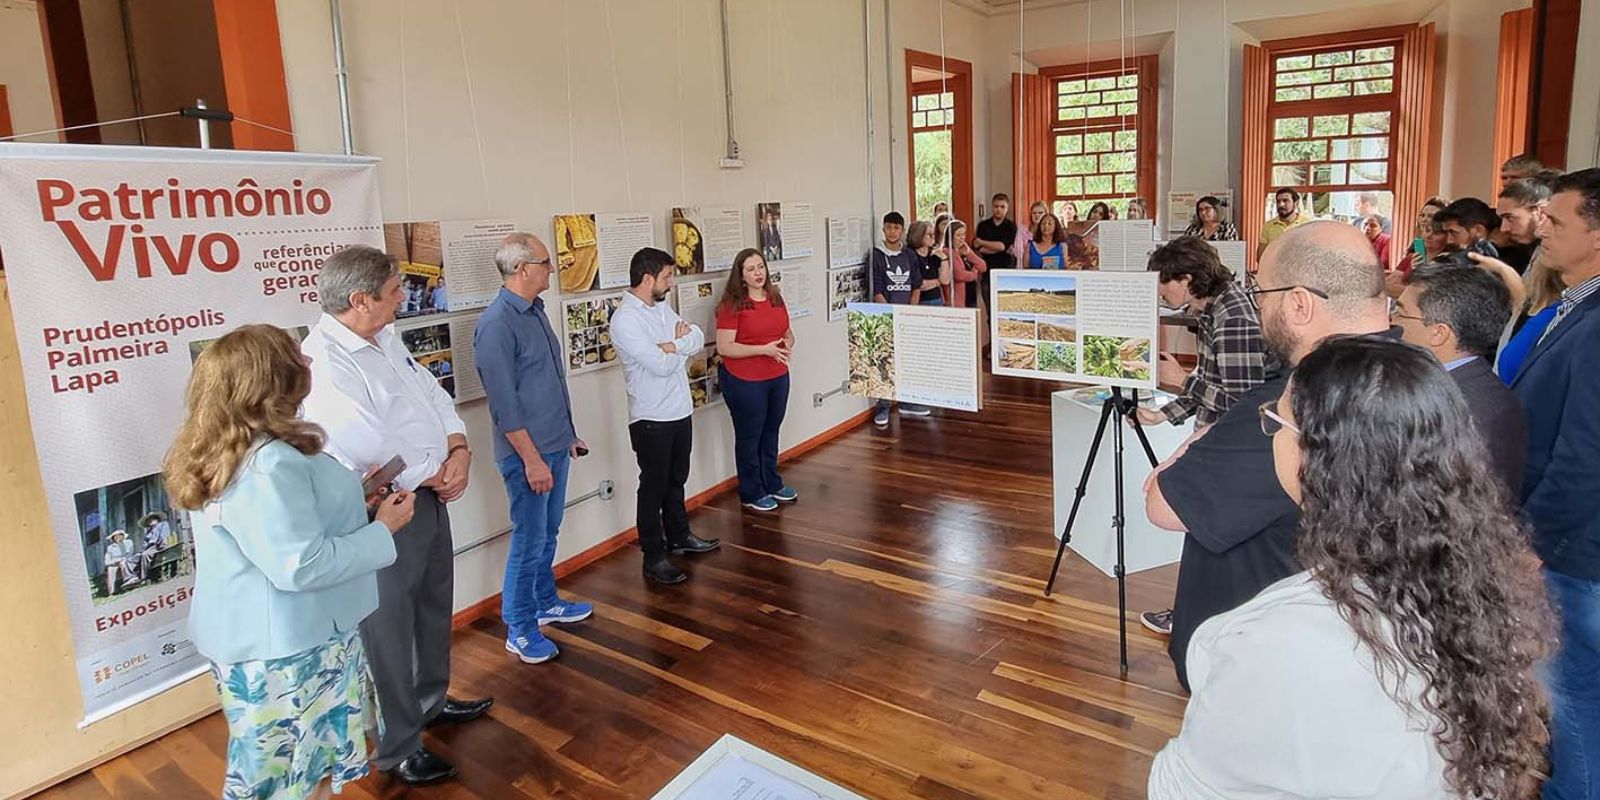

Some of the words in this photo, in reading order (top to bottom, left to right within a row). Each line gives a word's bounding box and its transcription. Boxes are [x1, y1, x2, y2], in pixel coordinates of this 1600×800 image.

[36, 178, 331, 221] Patrimônio
[56, 220, 240, 282] Vivo
[254, 260, 277, 272] que
[43, 309, 225, 346] Prudentópolis
[47, 339, 169, 370] Palmeira
[51, 370, 120, 394] Lapa
[113, 653, 150, 672] COPEL
